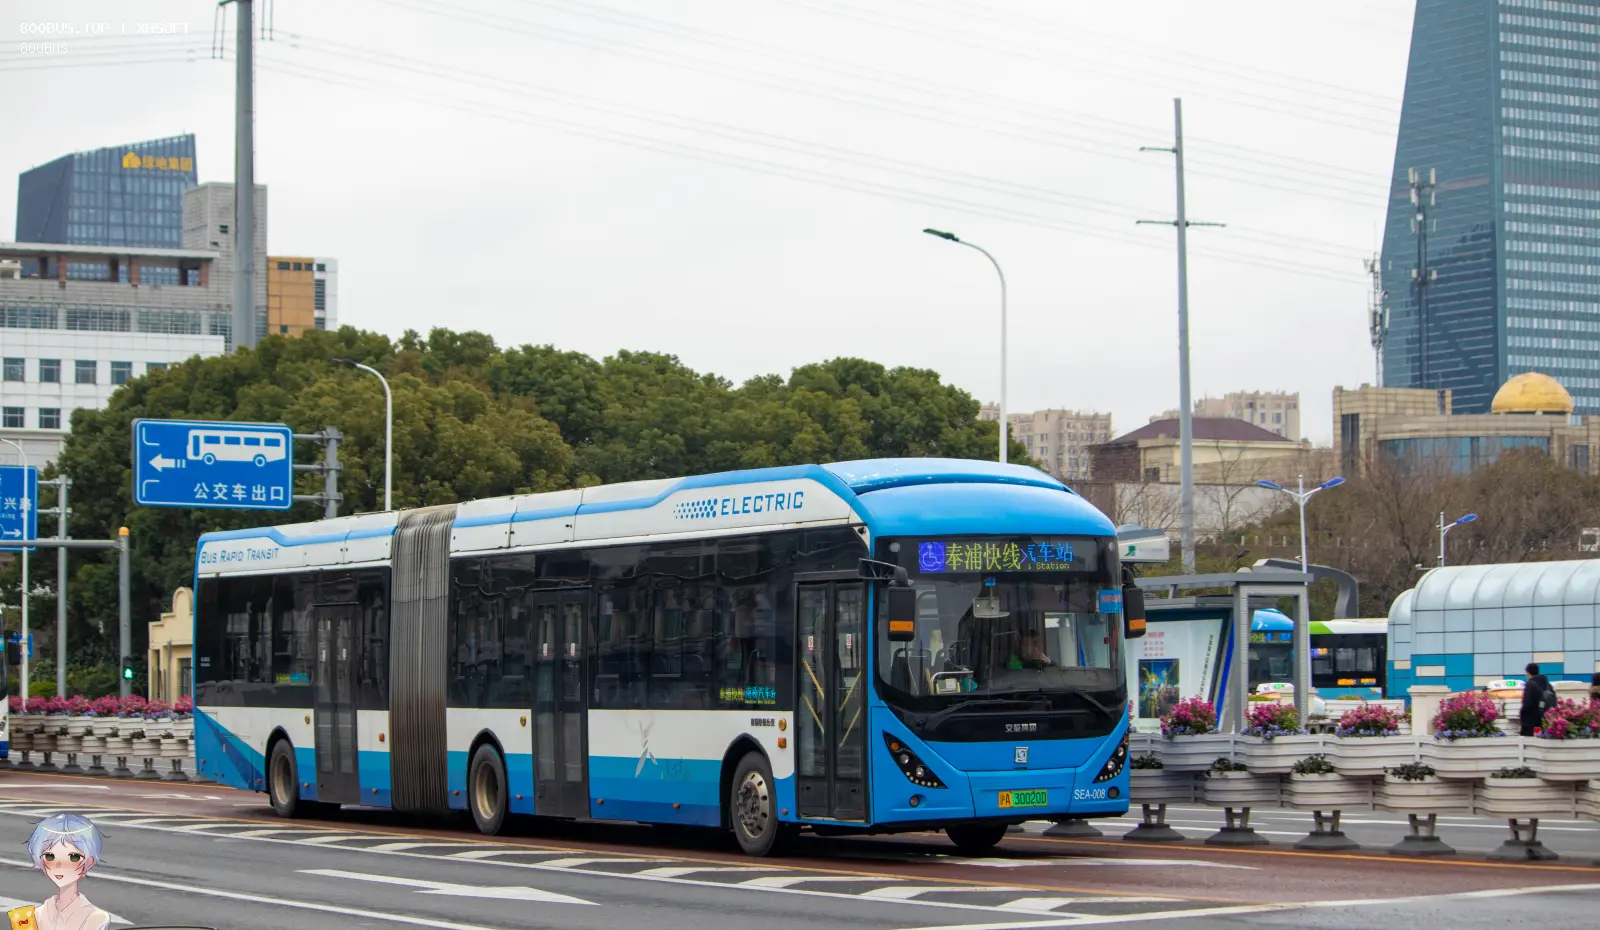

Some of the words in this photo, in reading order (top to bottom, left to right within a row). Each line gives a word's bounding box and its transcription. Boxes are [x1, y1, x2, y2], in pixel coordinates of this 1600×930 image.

[193, 482, 284, 502] 公交车出口
[0, 496, 32, 511] 兴路
[720, 491, 804, 516] ELECTRIC
[945, 542, 1021, 571] 奉浦快线
[1035, 561, 1070, 570] Station
[1014, 791, 1047, 806] 30020D
[1074, 788, 1106, 800] SEA-008
